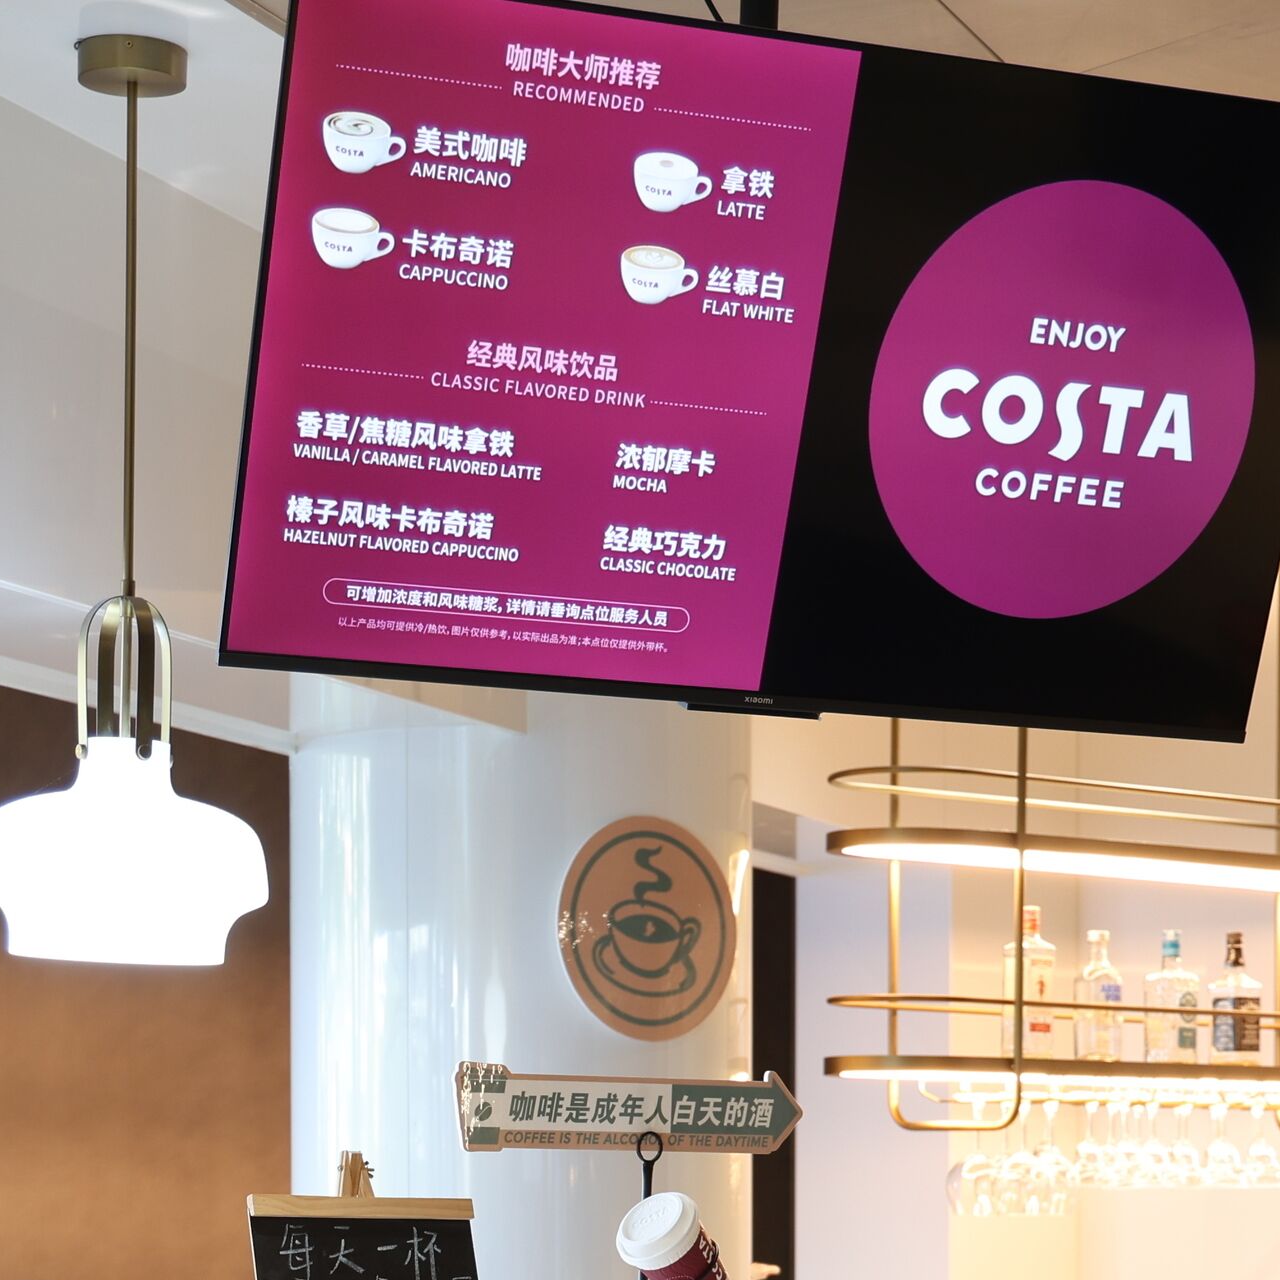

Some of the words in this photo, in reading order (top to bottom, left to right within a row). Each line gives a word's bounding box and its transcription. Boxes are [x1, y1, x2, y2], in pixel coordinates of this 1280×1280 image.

[505, 43, 662, 90] 咖啡大师推荐
[513, 81, 645, 113] RECOMMENDED
[335, 145, 365, 157] COSTA
[413, 126, 527, 167] 美式咖啡
[410, 161, 512, 188] AMERICANO
[721, 166, 775, 199] 拿铁
[717, 200, 766, 220] LATTE
[324, 241, 353, 252] COSTA
[402, 229, 514, 268] 卡布奇诺
[399, 263, 508, 290] CAPPUCCINO
[706, 265, 784, 300] 丝慕白
[702, 299, 740, 317] FLAT
[743, 304, 795, 323] WHITE
[1030, 318, 1127, 353] ENJOY
[466, 340, 618, 382] 经典风味饮品
[431, 372, 500, 393] CLASSIC
[504, 380, 590, 402] FLAVORED
[594, 389, 646, 408] DRINK
[922, 368, 1194, 462] COSTA
[296, 410, 515, 458] 香草/焦糖风味拿铁
[293, 443, 351, 463] VANILLA
[361, 450, 425, 470] CARAMEL
[428, 456, 497, 476] FLAVORED
[500, 464, 542, 481] LATTE
[615, 443, 716, 477] 浓郁摩卡
[612, 475, 667, 493] MOCHA
[975, 467, 1124, 509] COFFEE
[286, 495, 494, 540] 榛子风味卡布奇诺
[283, 528, 357, 547] HAZELNUT
[359, 535, 429, 554] FLAVORED
[431, 541, 519, 562] CAPPUCCINO
[603, 524, 726, 561] 经典巧克力
[600, 556, 655, 574] CLASSIC
[656, 562, 737, 581] CHOCOLATE
[508, 1090, 775, 1129] 咖啡是成年人白天的酒
[504, 1131, 558, 1144] COFFEE
[559, 1132, 571, 1144] IS
[575, 1132, 602, 1145] THE
[667, 1134, 686, 1145] OF
[689, 1135, 715, 1146] THE
[716, 1136, 769, 1148] DAYTIME
